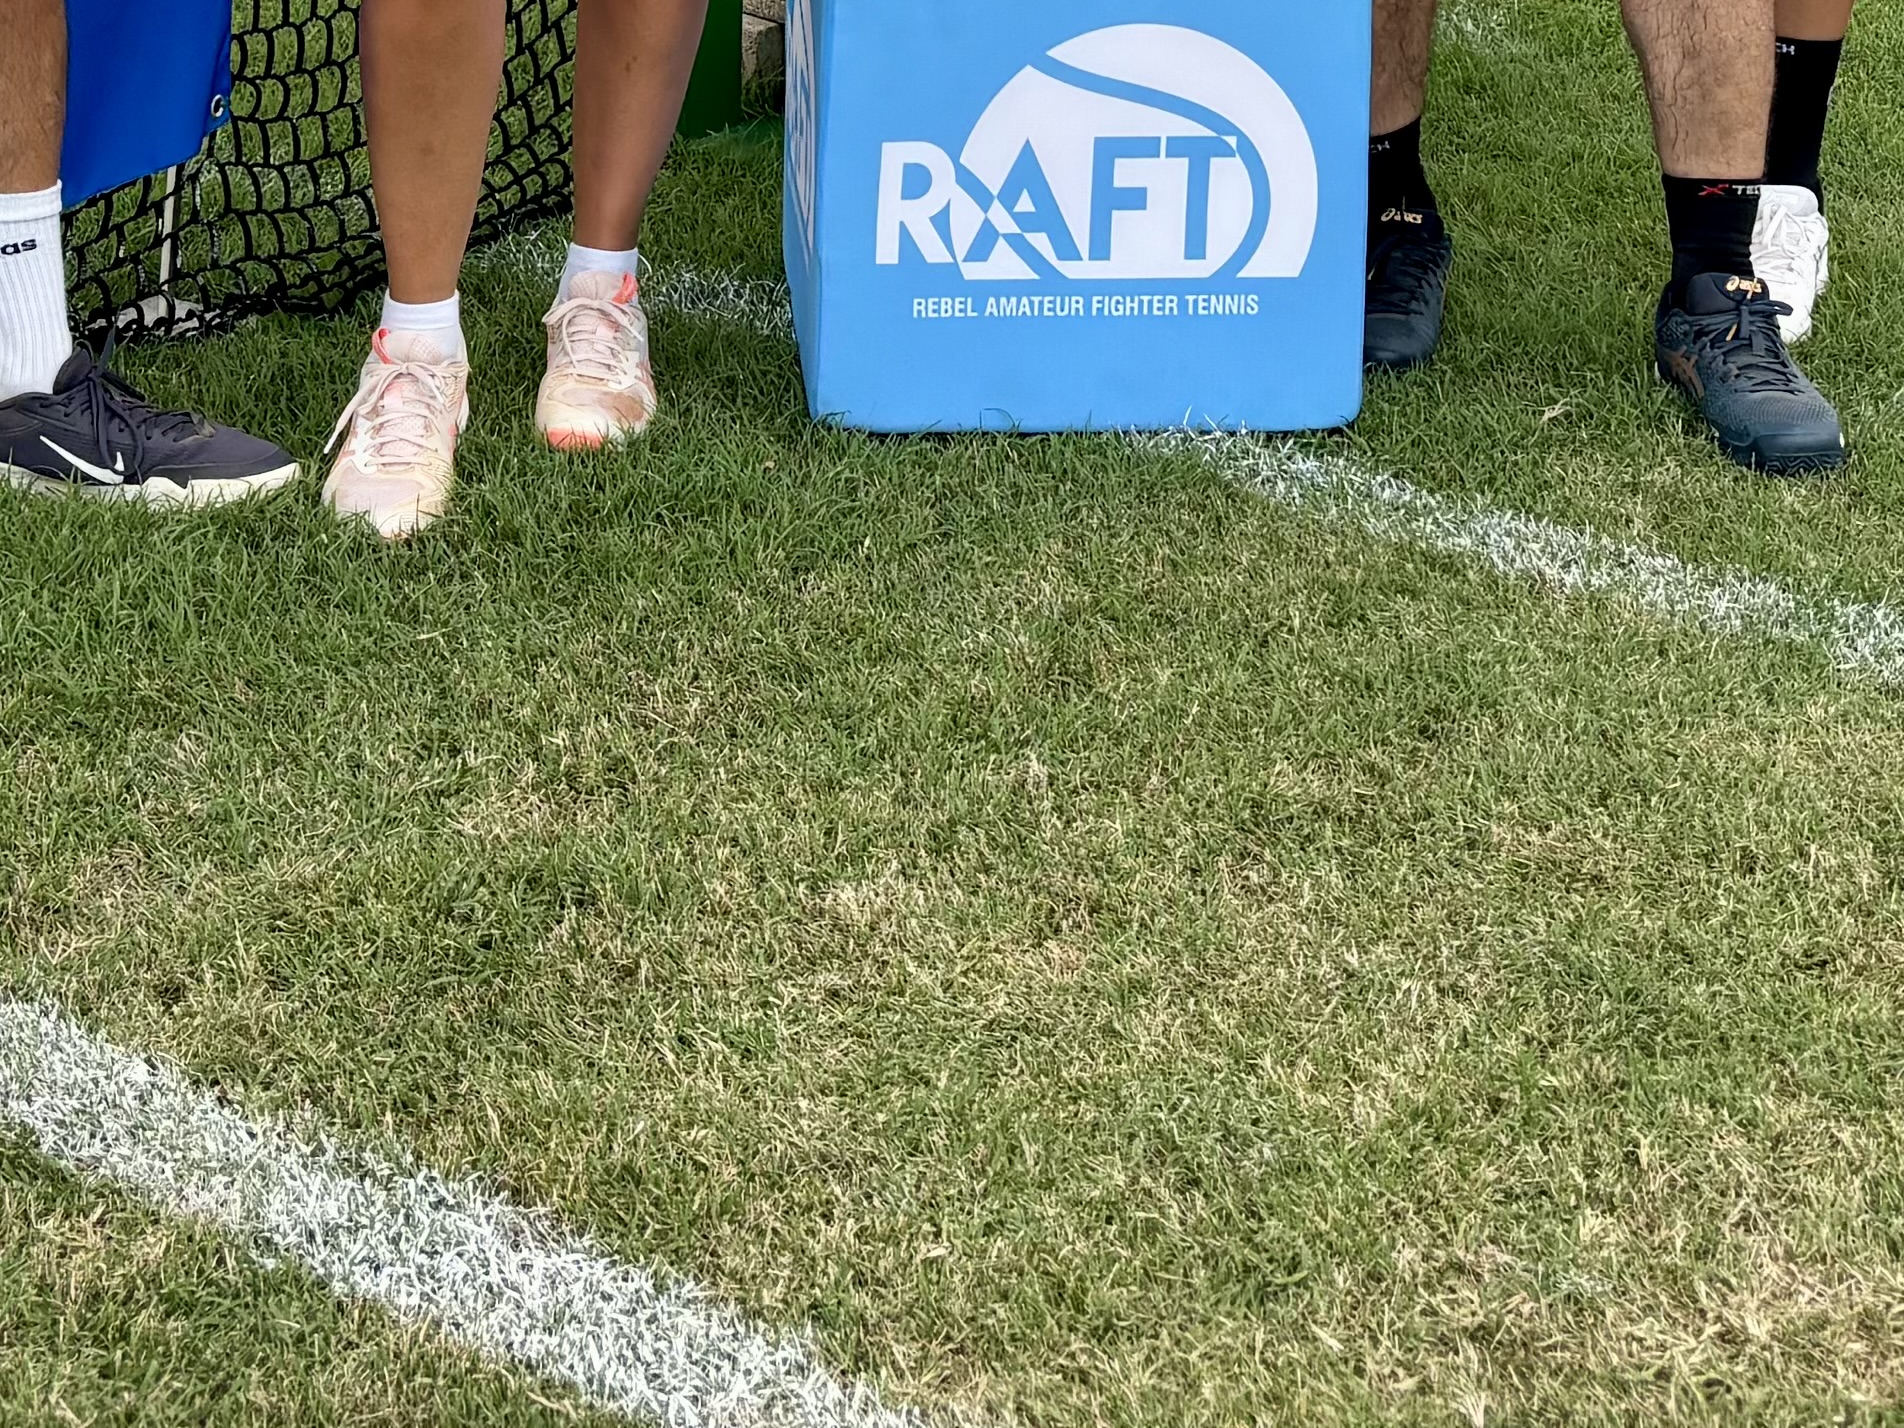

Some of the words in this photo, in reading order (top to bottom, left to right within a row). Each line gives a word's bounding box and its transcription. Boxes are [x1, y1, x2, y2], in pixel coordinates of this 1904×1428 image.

[875, 135, 1238, 265] RAFT
[1732, 184, 1760, 195] TE
[912, 297, 978, 319] REBEL
[984, 296, 1085, 318] AMATEUR
[1091, 295, 1179, 317] FIGHTER
[1185, 294, 1260, 316] TENNIS
